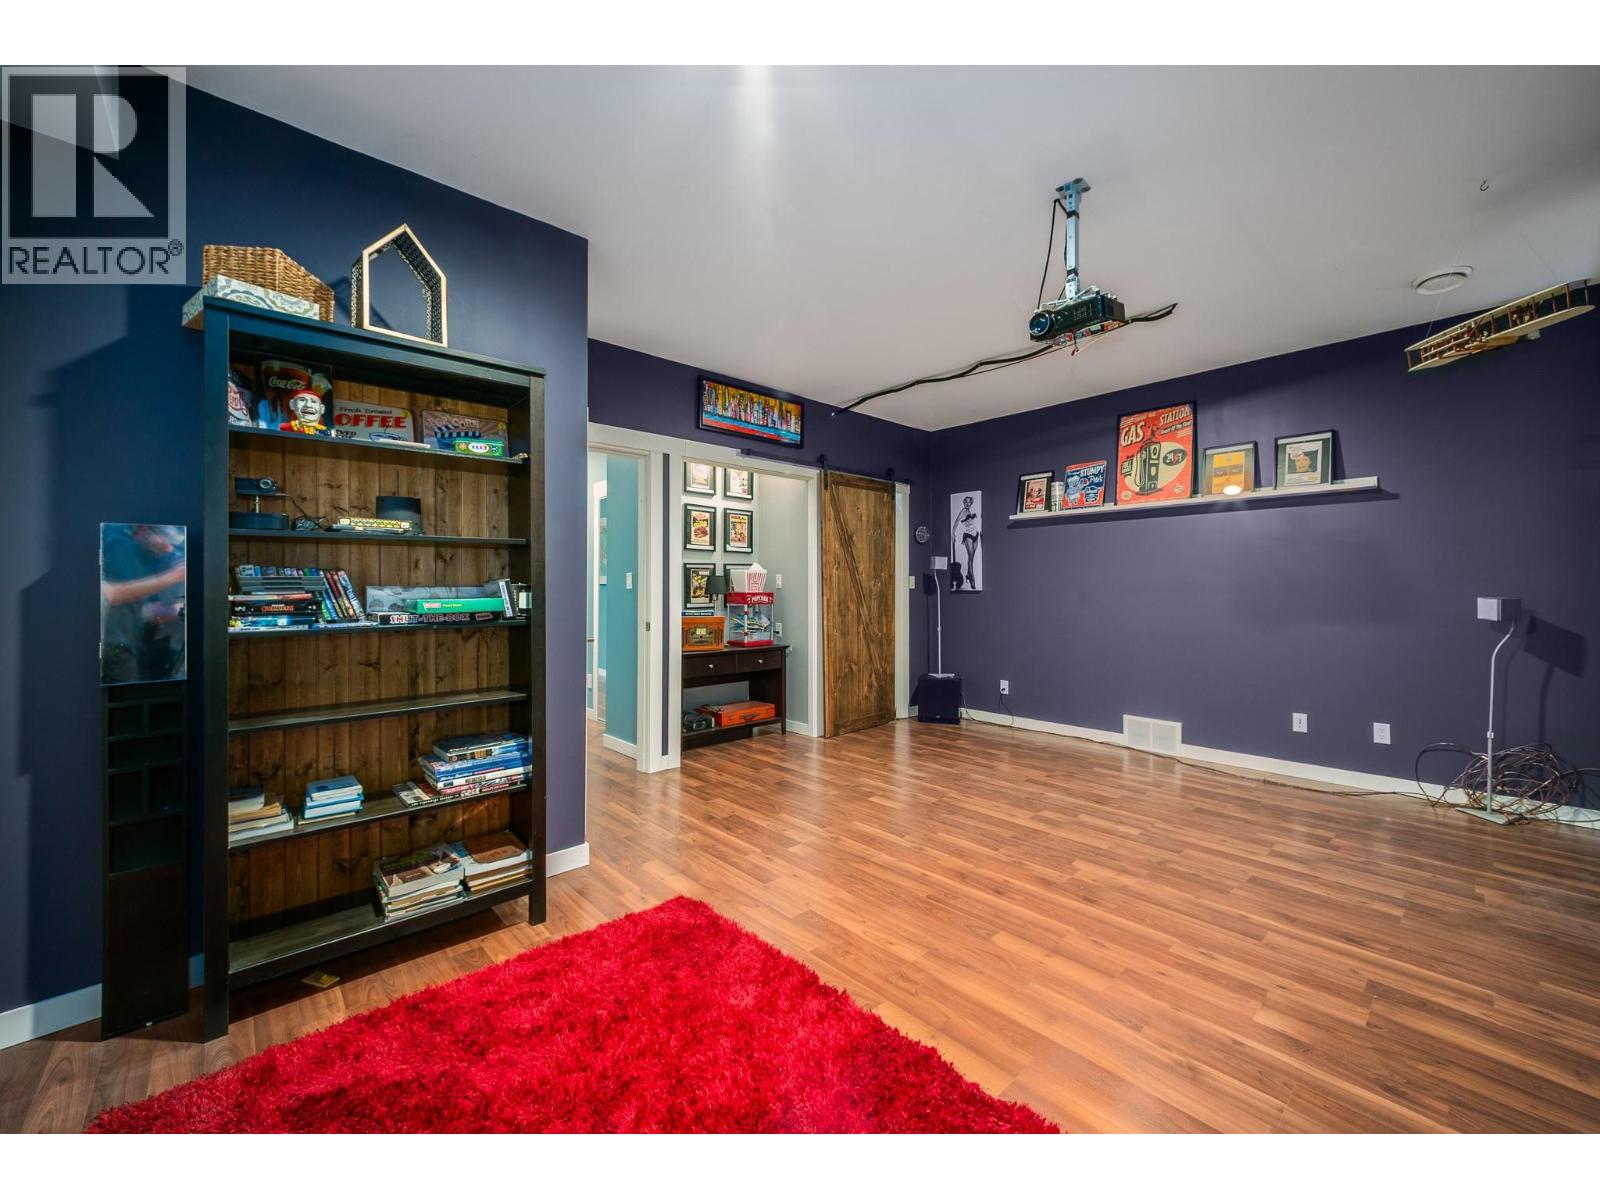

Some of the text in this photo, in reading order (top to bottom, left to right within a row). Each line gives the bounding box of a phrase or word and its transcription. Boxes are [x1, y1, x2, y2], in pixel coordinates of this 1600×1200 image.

[334, 412, 408, 428] OFFEE
[452, 416, 481, 430] CORN
[1159, 406, 1191, 426] STATION
[1120, 420, 1146, 447] GAS
[1080, 464, 1105, 478] STUMPY
[389, 612, 471, 625] SHUT-THE-BOX
